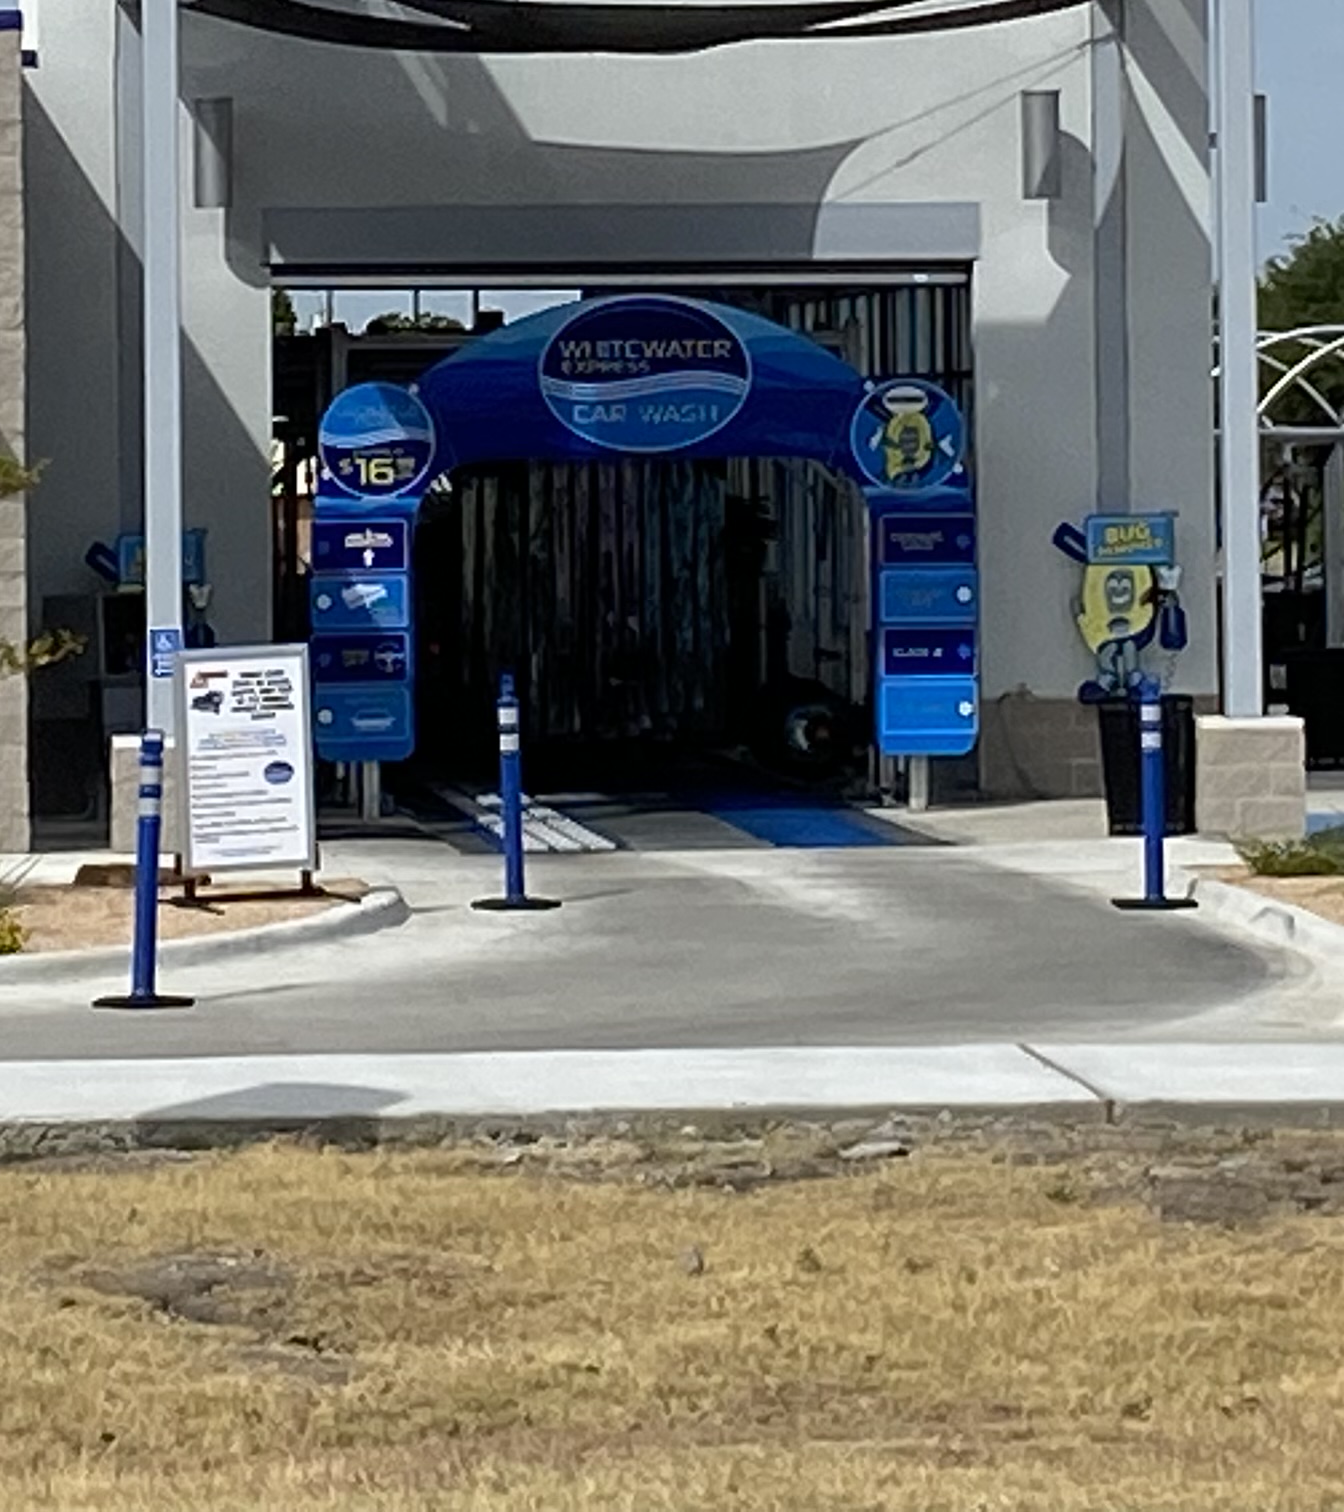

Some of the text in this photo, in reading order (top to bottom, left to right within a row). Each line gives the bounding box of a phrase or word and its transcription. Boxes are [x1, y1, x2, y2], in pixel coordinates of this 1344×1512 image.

[558, 338, 733, 359] WHITEWATER
[560, 358, 651, 375] EXPRESS
[572, 403, 720, 425] CAR WASH
